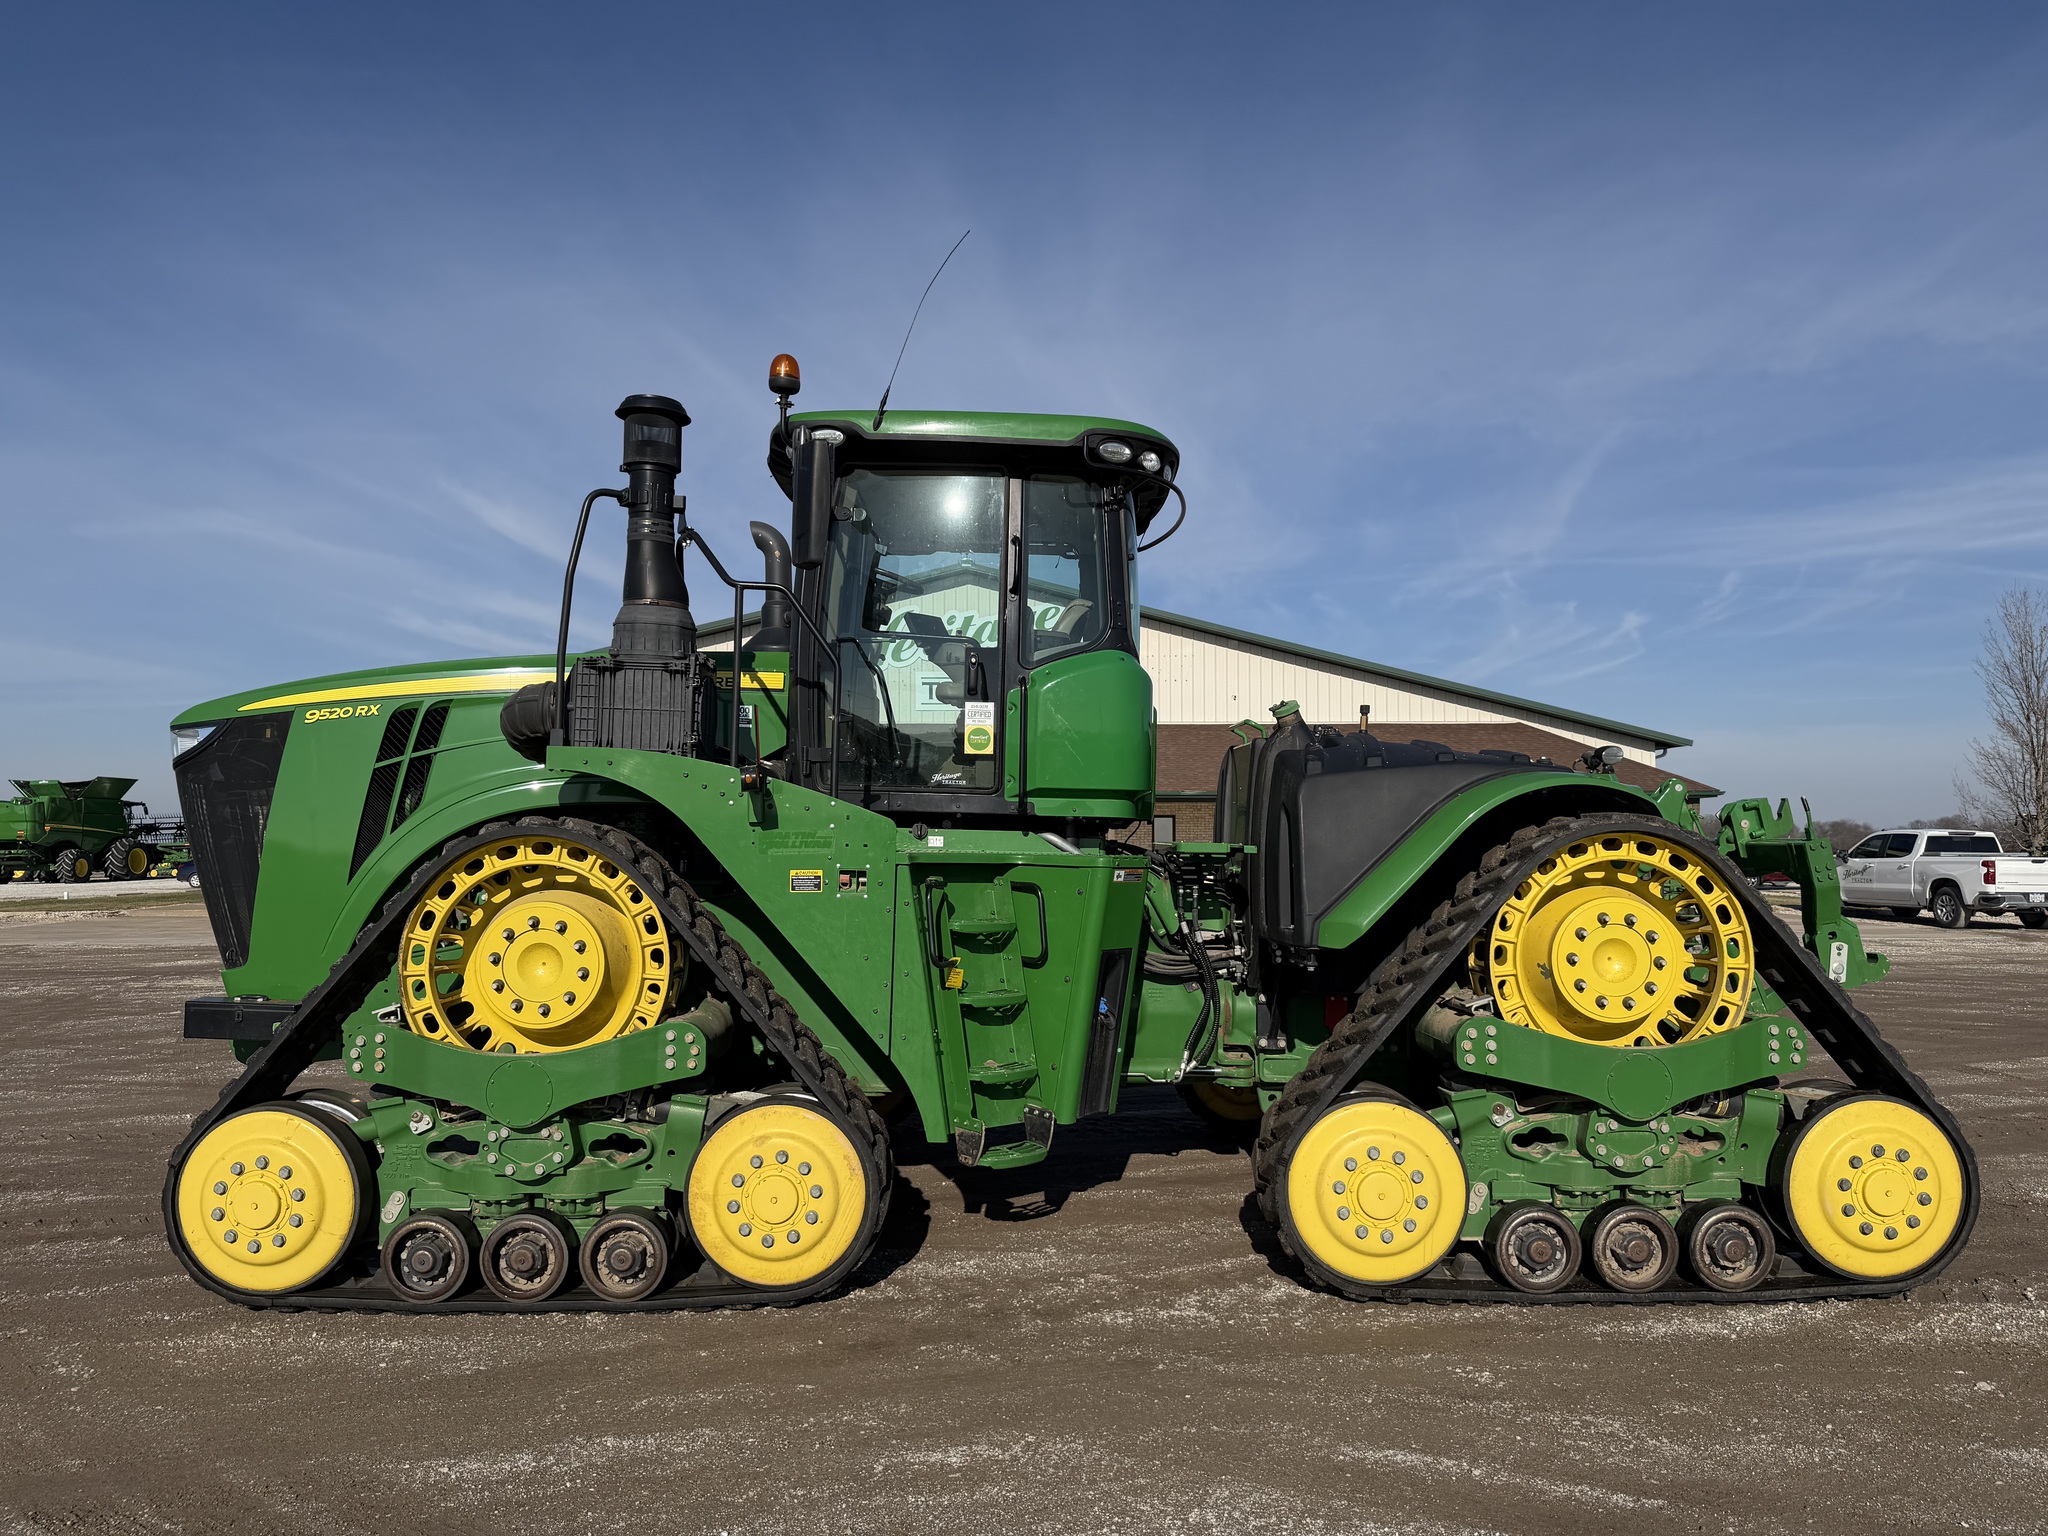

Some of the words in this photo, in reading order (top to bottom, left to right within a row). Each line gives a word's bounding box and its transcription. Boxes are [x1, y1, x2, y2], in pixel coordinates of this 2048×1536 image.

[304, 708, 354, 723] 9520
[354, 704, 382, 717] RX
[931, 773, 961, 782] Heritage
